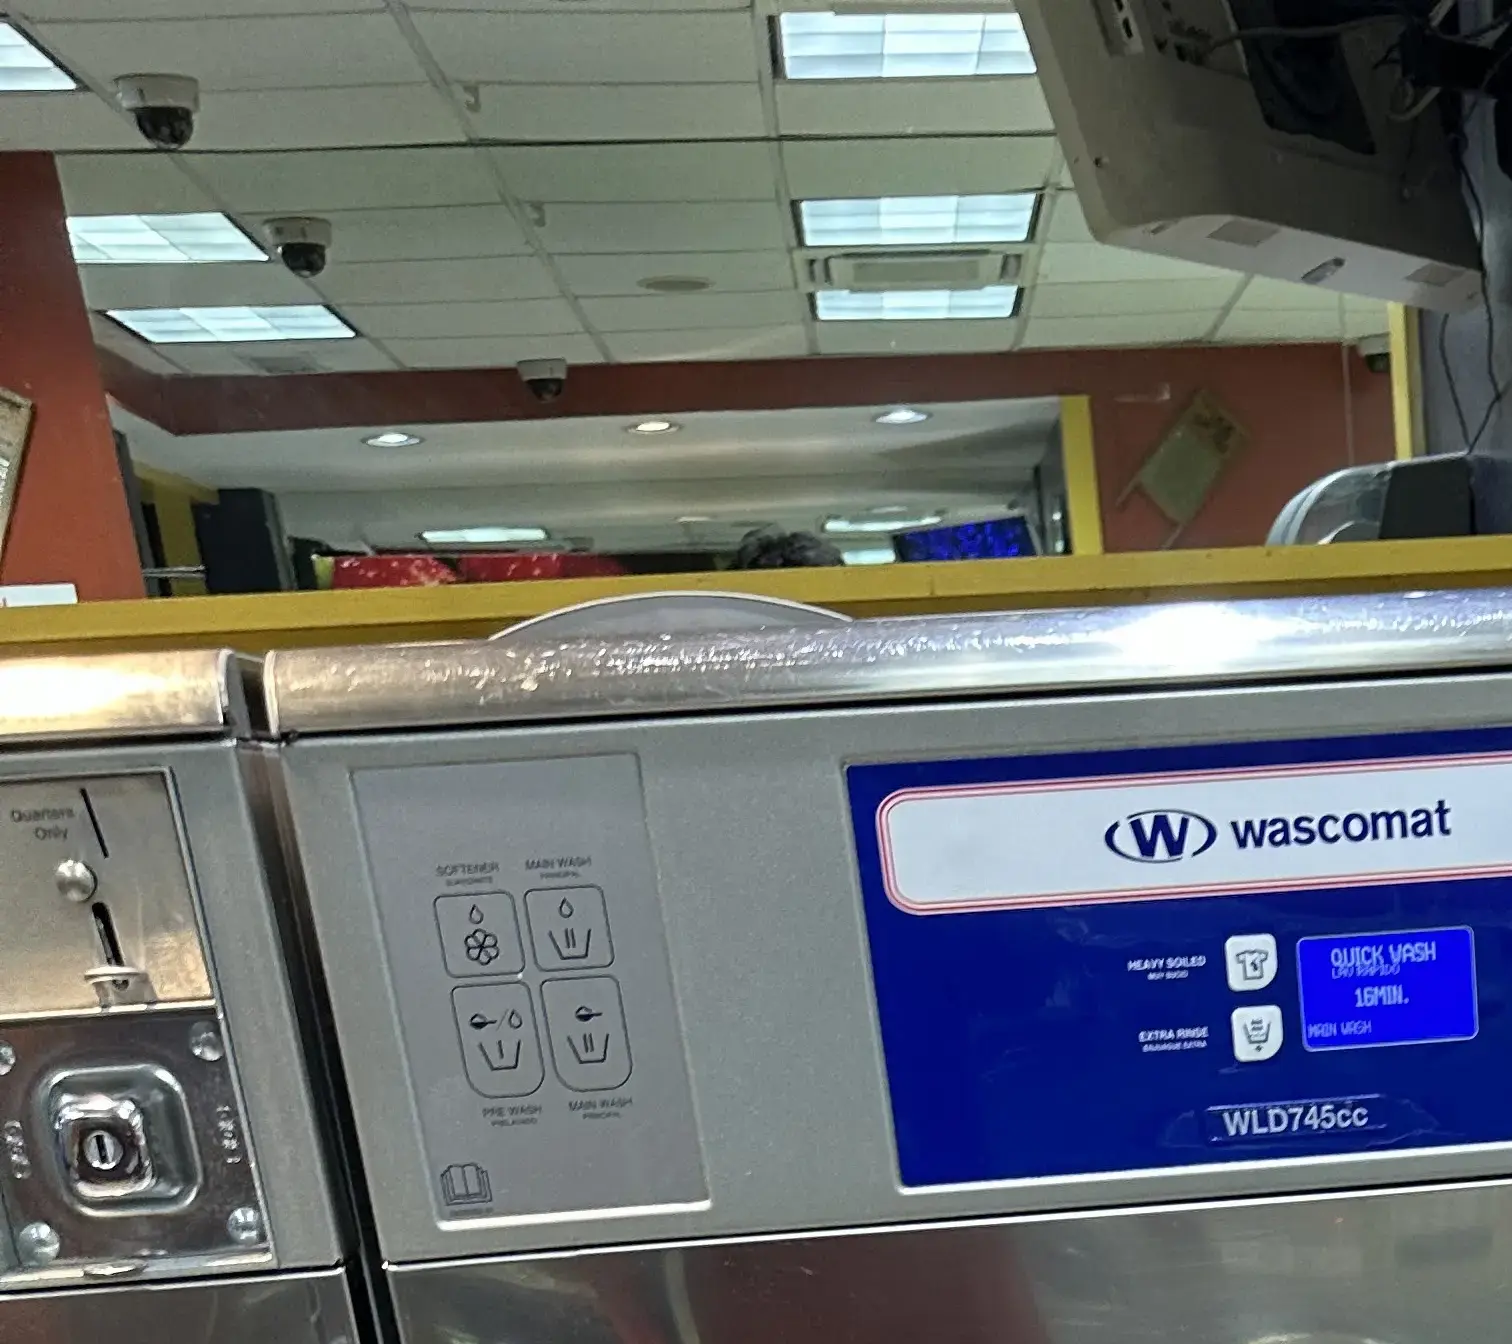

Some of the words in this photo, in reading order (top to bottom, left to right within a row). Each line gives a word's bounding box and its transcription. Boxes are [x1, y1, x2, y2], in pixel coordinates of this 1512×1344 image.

[11, 807, 76, 823] Quarters
[34, 825, 69, 842] Only
[1229, 799, 1453, 850] wascomat
[1330, 943, 1385, 968] QUICK
[1389, 940, 1437, 964] WASH
[1127, 957, 1165, 972] HEAVY
[1138, 1028, 1175, 1043] EXTRA
[1307, 1021, 1337, 1039] MAIN
[1340, 1019, 1373, 1036] WASH
[1221, 1104, 1369, 1137] WLD745cc
